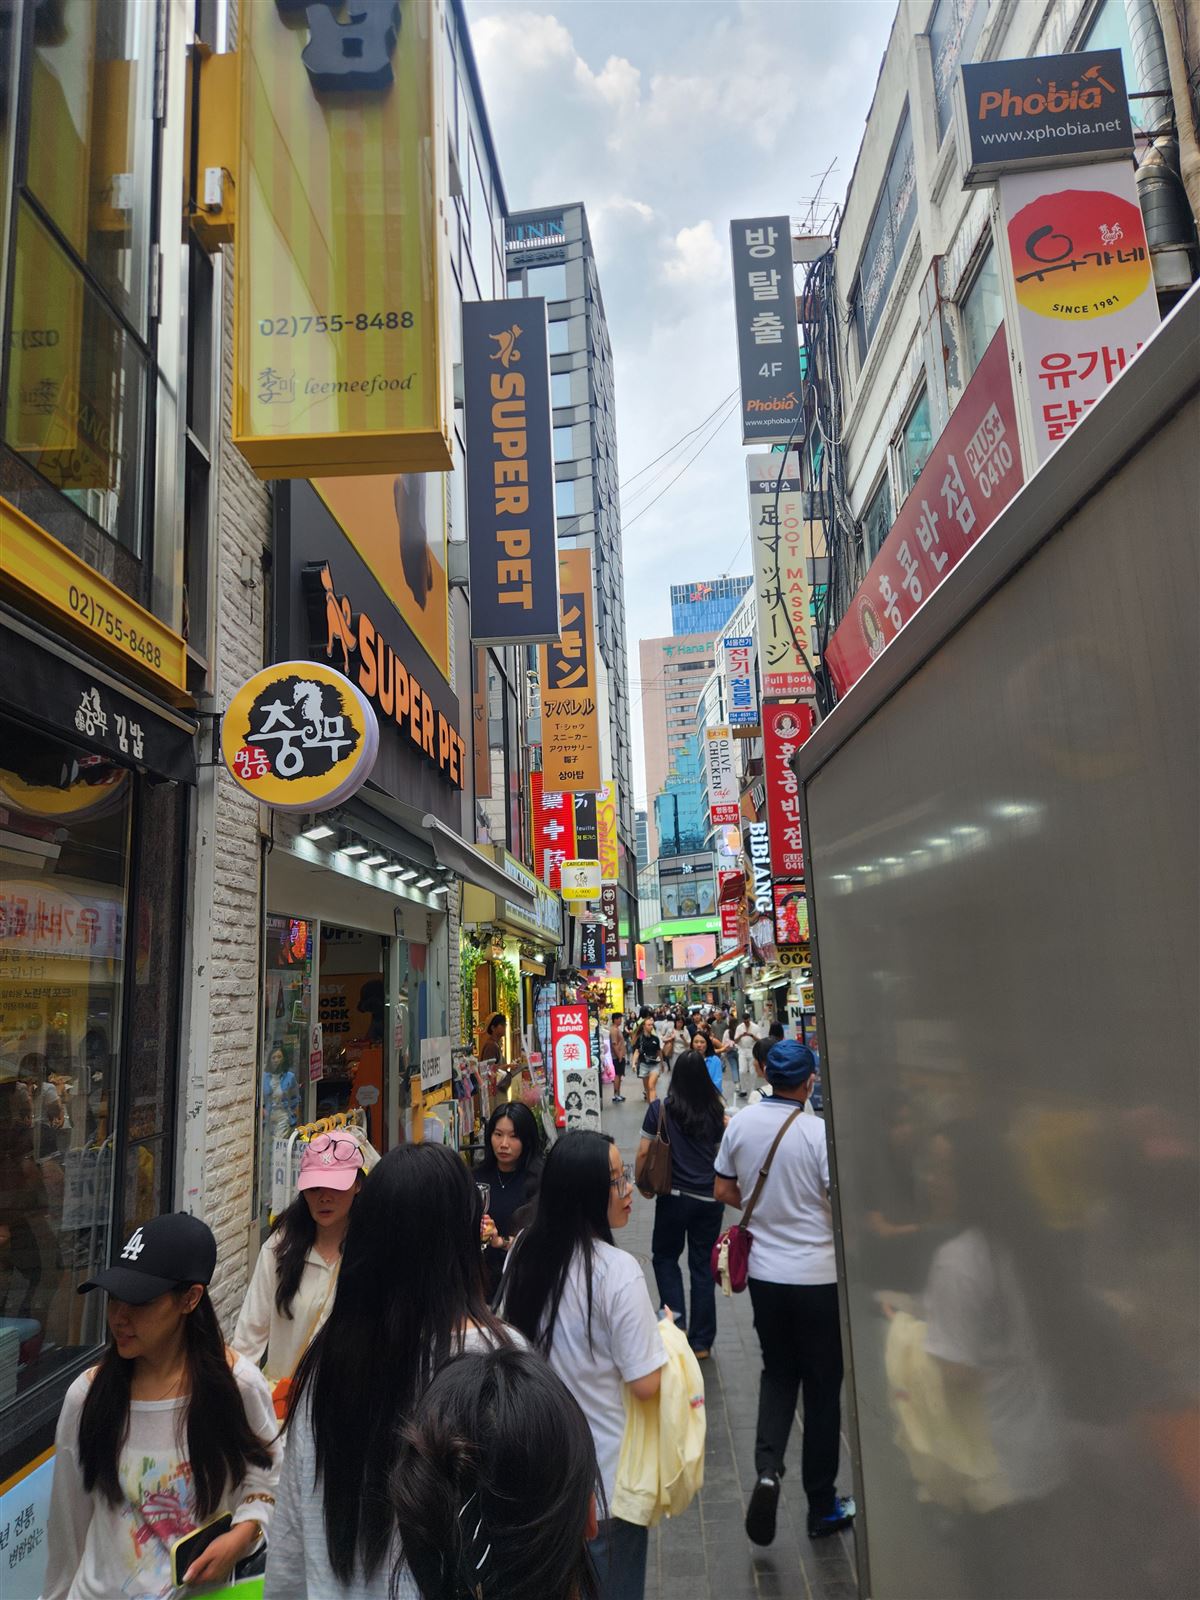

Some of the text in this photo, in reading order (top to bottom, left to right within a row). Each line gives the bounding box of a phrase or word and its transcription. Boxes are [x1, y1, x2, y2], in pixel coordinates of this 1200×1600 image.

[979, 80, 1103, 120] Phobia
[981, 119, 1121, 145] www.xphobia.net
[1015, 224, 1145, 284] 유가네
[745, 227, 784, 344] 방탈출
[1052, 295, 1120, 314] SINCE 1981
[258, 311, 415, 338] 02)755-8488
[304, 372, 418, 397] leemeefood
[758, 362, 782, 378] 4F
[746, 396, 795, 412] Phobia
[1043, 399, 1101, 441] 닭
[979, 441, 1013, 498] 0410
[490, 372, 533, 610] SUPER PET
[879, 454, 976, 632] 홍콩반점
[783, 503, 809, 666] FOOT MASSAGE
[68, 585, 162, 669] 02)755-8488
[678, 643, 705, 655] Hana
[728, 648, 749, 674] 전기
[764, 674, 813, 685] Full Body
[358, 612, 466, 790] SUPER PET
[544, 697, 595, 718] アパレル
[113, 713, 145, 760] 김밥
[248, 699, 352, 777] 충무
[553, 733, 588, 742] スニーカー
[234, 749, 270, 778] 명동
[708, 739, 732, 790] OLIVE CHICKEN
[556, 1012, 582, 1025] TAX
[556, 1024, 583, 1033] REFUND
[120, 1226, 145, 1261] LA
